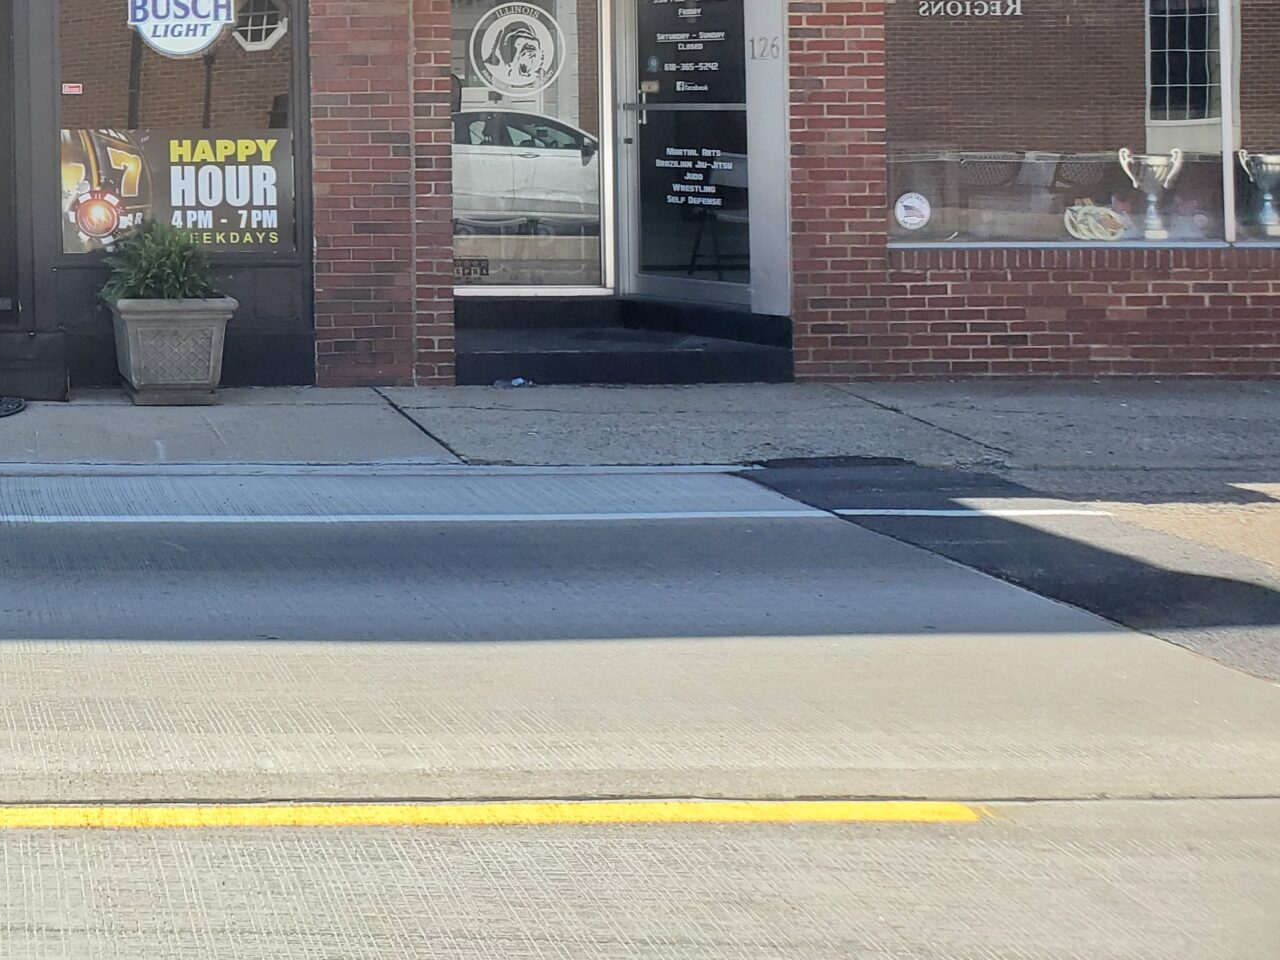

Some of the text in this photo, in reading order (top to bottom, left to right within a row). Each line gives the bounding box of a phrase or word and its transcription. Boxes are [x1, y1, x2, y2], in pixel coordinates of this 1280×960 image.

[495, 6, 540, 19] ILLINOIS
[151, 23, 211, 38] LIGHT
[677, 43, 703, 51] CLOSED
[749, 37, 780, 60] 126
[170, 139, 278, 162] HAPPY
[666, 147, 722, 157] MARTIAL ARTS
[655, 159, 733, 170] BRAZILIAN JIU-JITSU
[684, 172, 704, 181] JUDO
[170, 165, 278, 207] HOUR
[672, 184, 716, 193] WRESTLING
[666, 195, 722, 205] SELF DEFENSE
[173, 231, 279, 244] EEKDAYS
